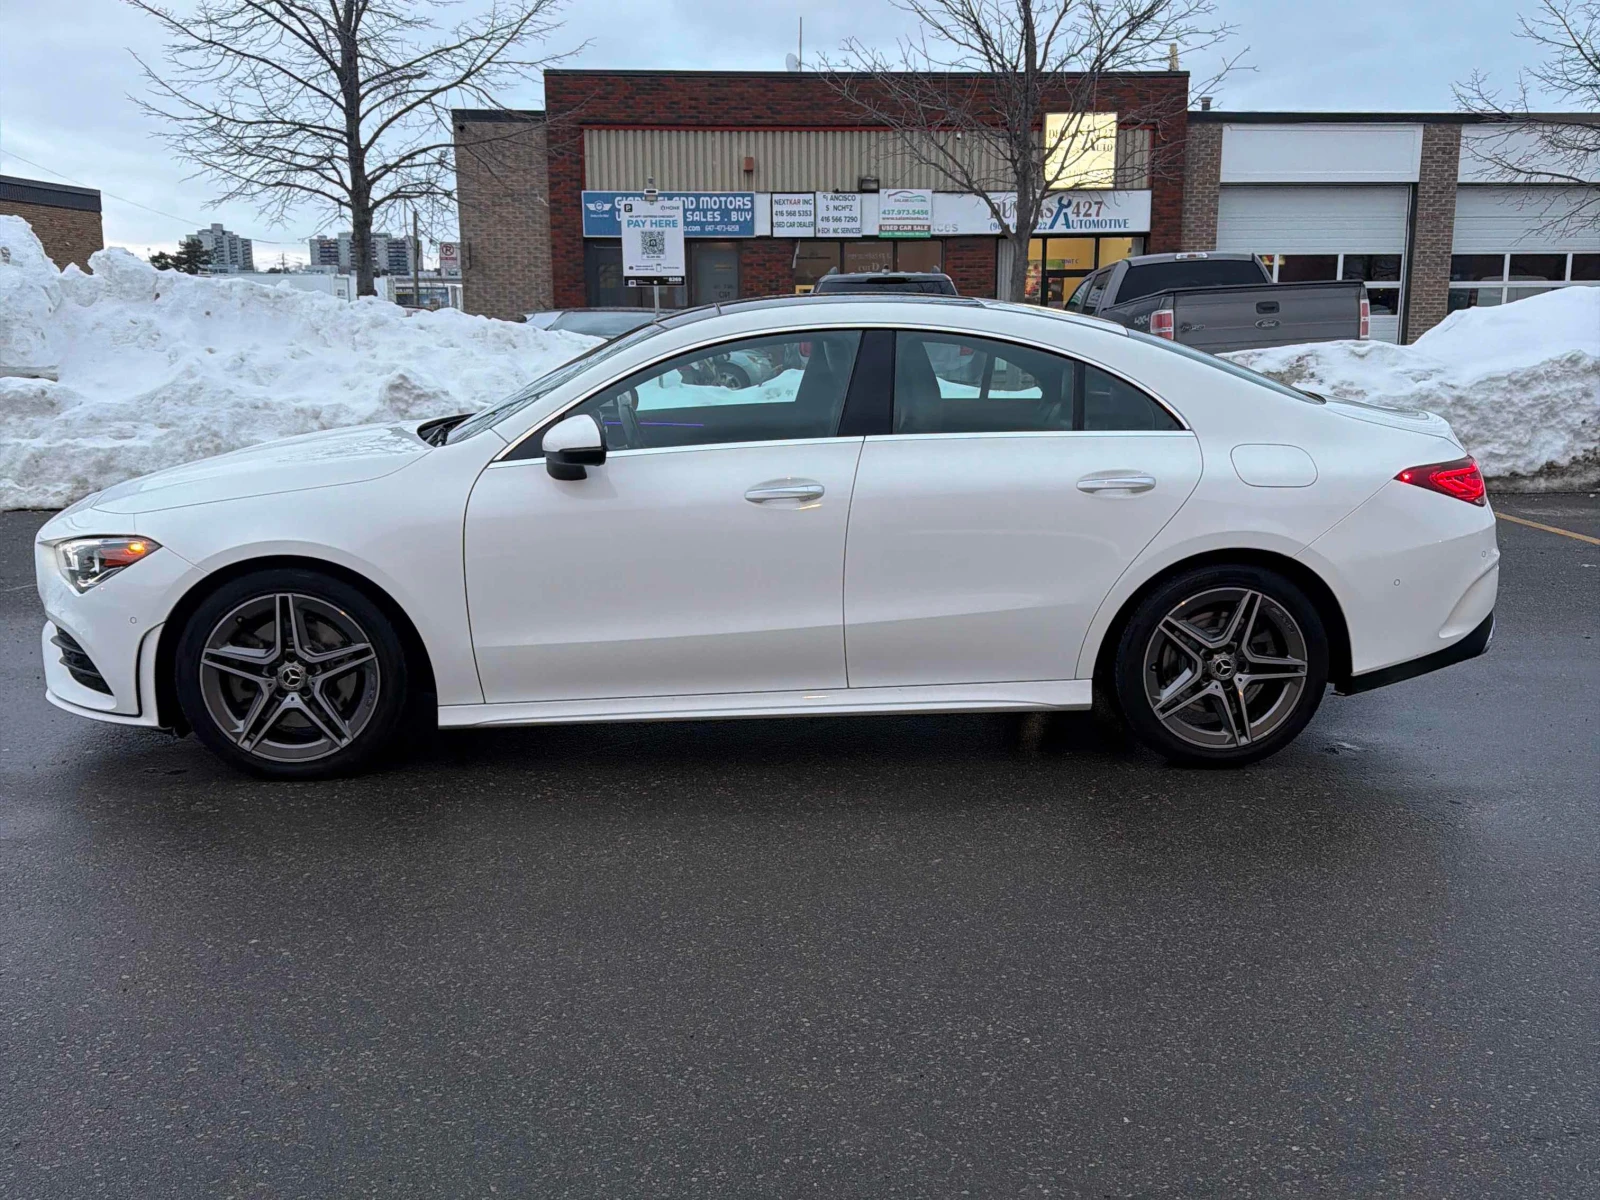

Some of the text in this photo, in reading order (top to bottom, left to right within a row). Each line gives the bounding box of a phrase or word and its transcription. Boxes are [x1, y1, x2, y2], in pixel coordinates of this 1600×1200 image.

[700, 197, 752, 209] MOTORS
[1071, 200, 1104, 217] 427
[686, 211, 752, 221] SALES BUY
[627, 219, 678, 228] PAY HERE
